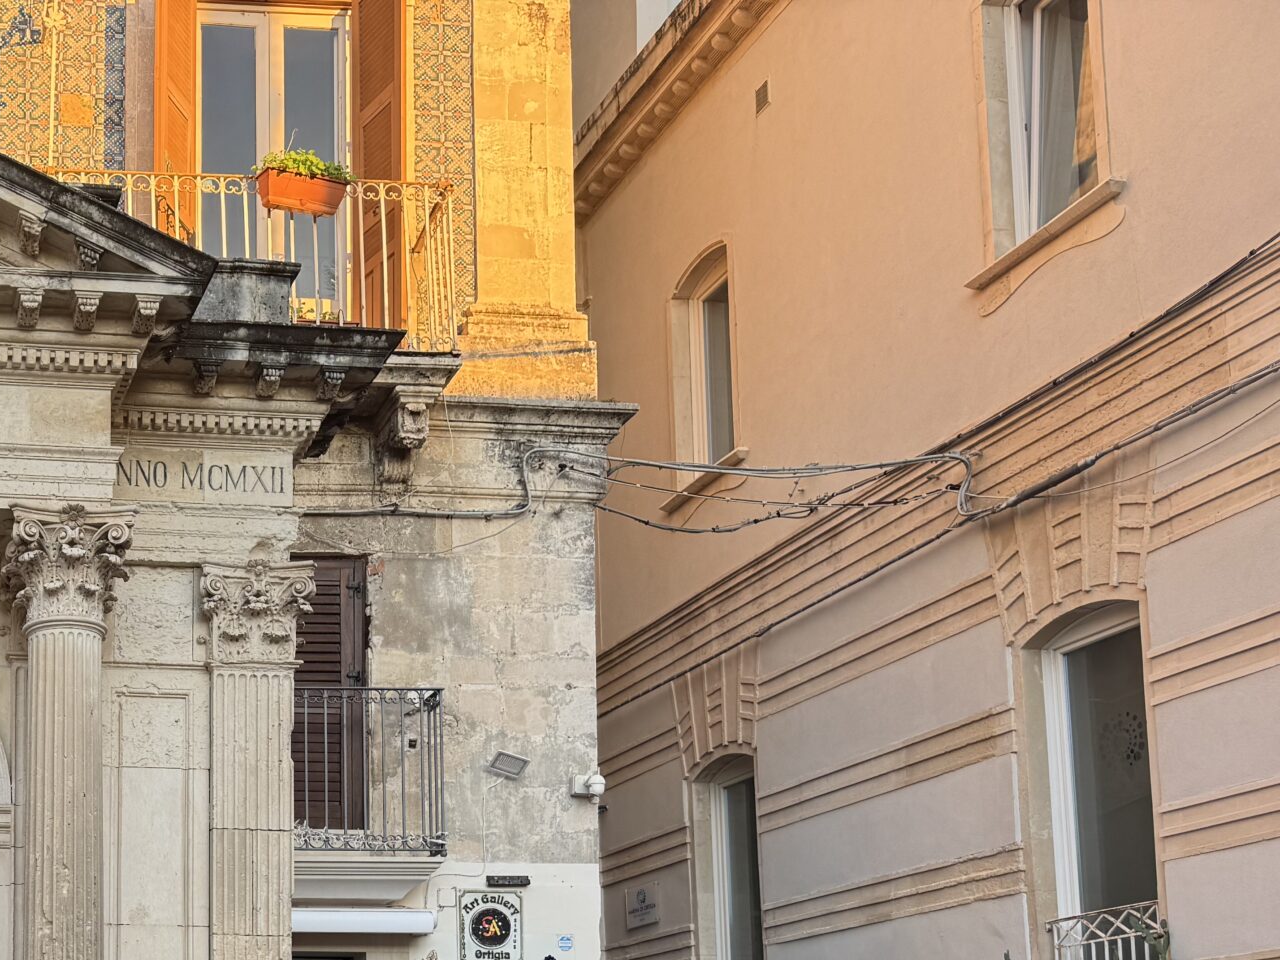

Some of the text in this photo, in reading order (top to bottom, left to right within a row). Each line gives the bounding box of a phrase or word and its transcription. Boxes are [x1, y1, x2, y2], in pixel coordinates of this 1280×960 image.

[181, 461, 286, 494] MCMXII
[463, 894, 520, 916] Art Gallery
[475, 950, 511, 960] Ortigia
